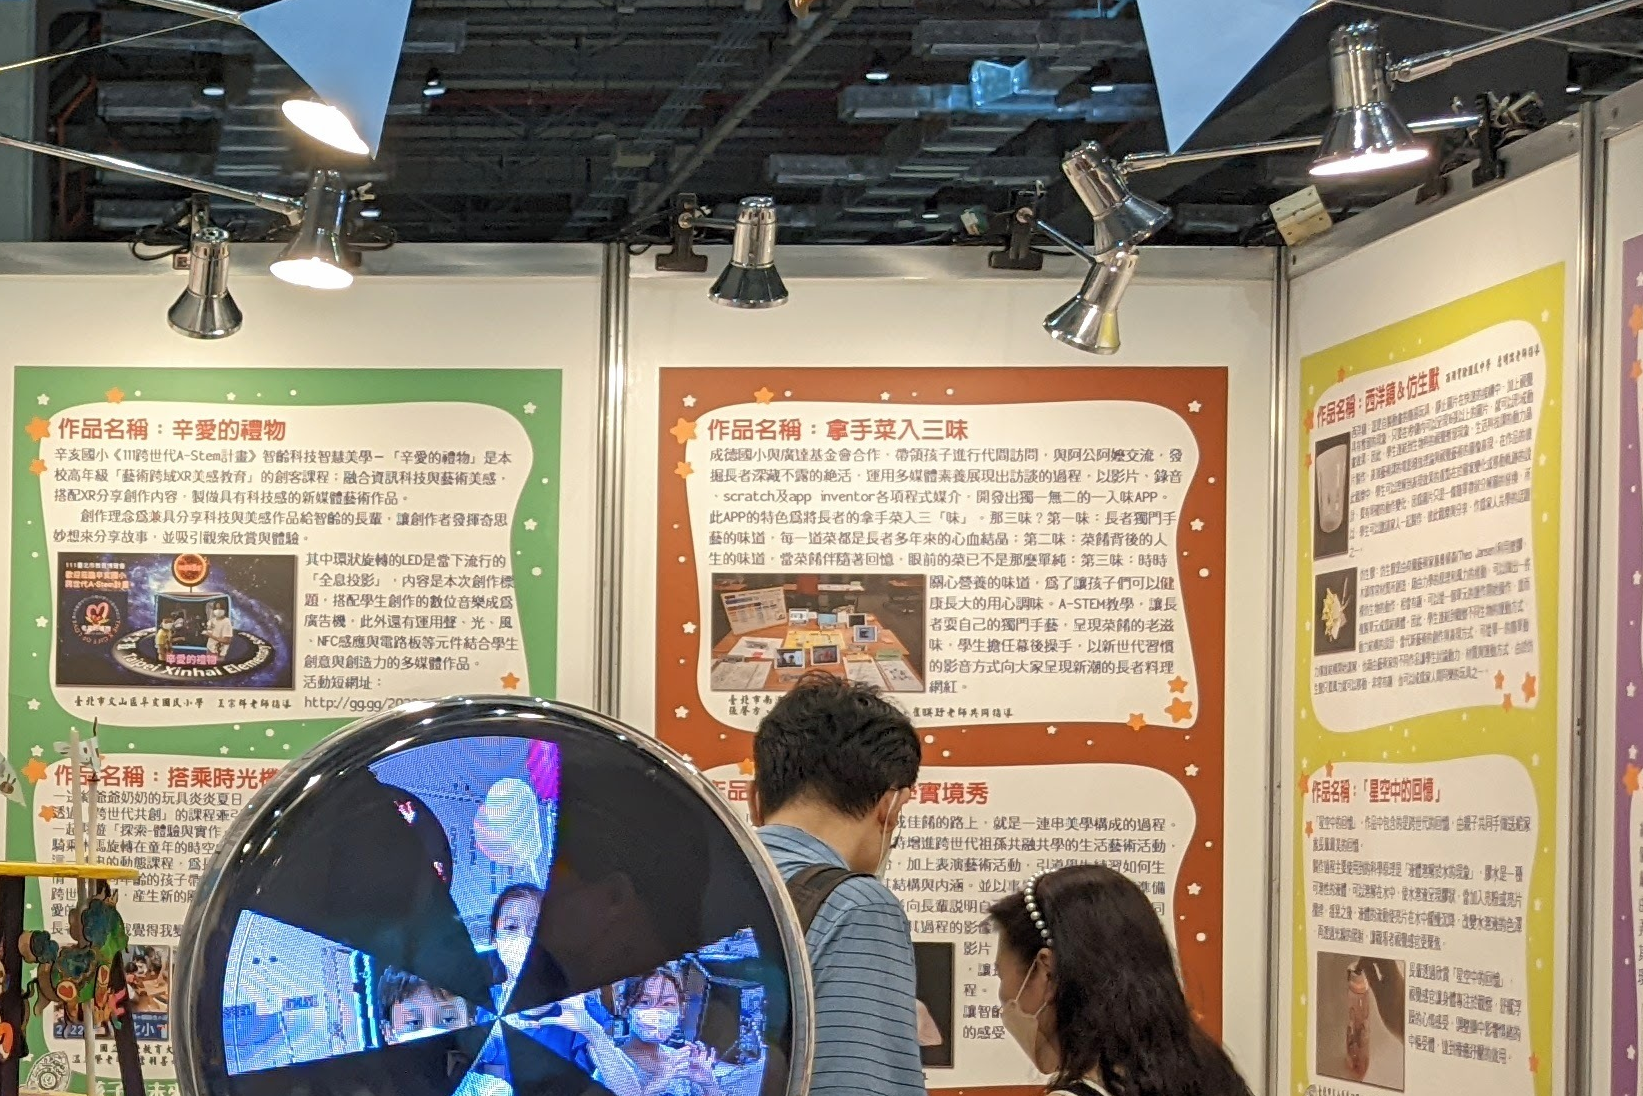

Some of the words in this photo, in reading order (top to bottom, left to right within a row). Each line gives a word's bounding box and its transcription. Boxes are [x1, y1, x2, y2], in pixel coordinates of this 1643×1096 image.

[58, 418, 287, 441] 作品名稱：辛愛的禮物
[707, 418, 969, 441] 作品名稱：拿手菜入三味
[122, 653, 161, 673] Taipei
[161, 666, 221, 677] Xinhai
[964, 941, 991, 955] 影片
[963, 1025, 1005, 1039] 的感受
